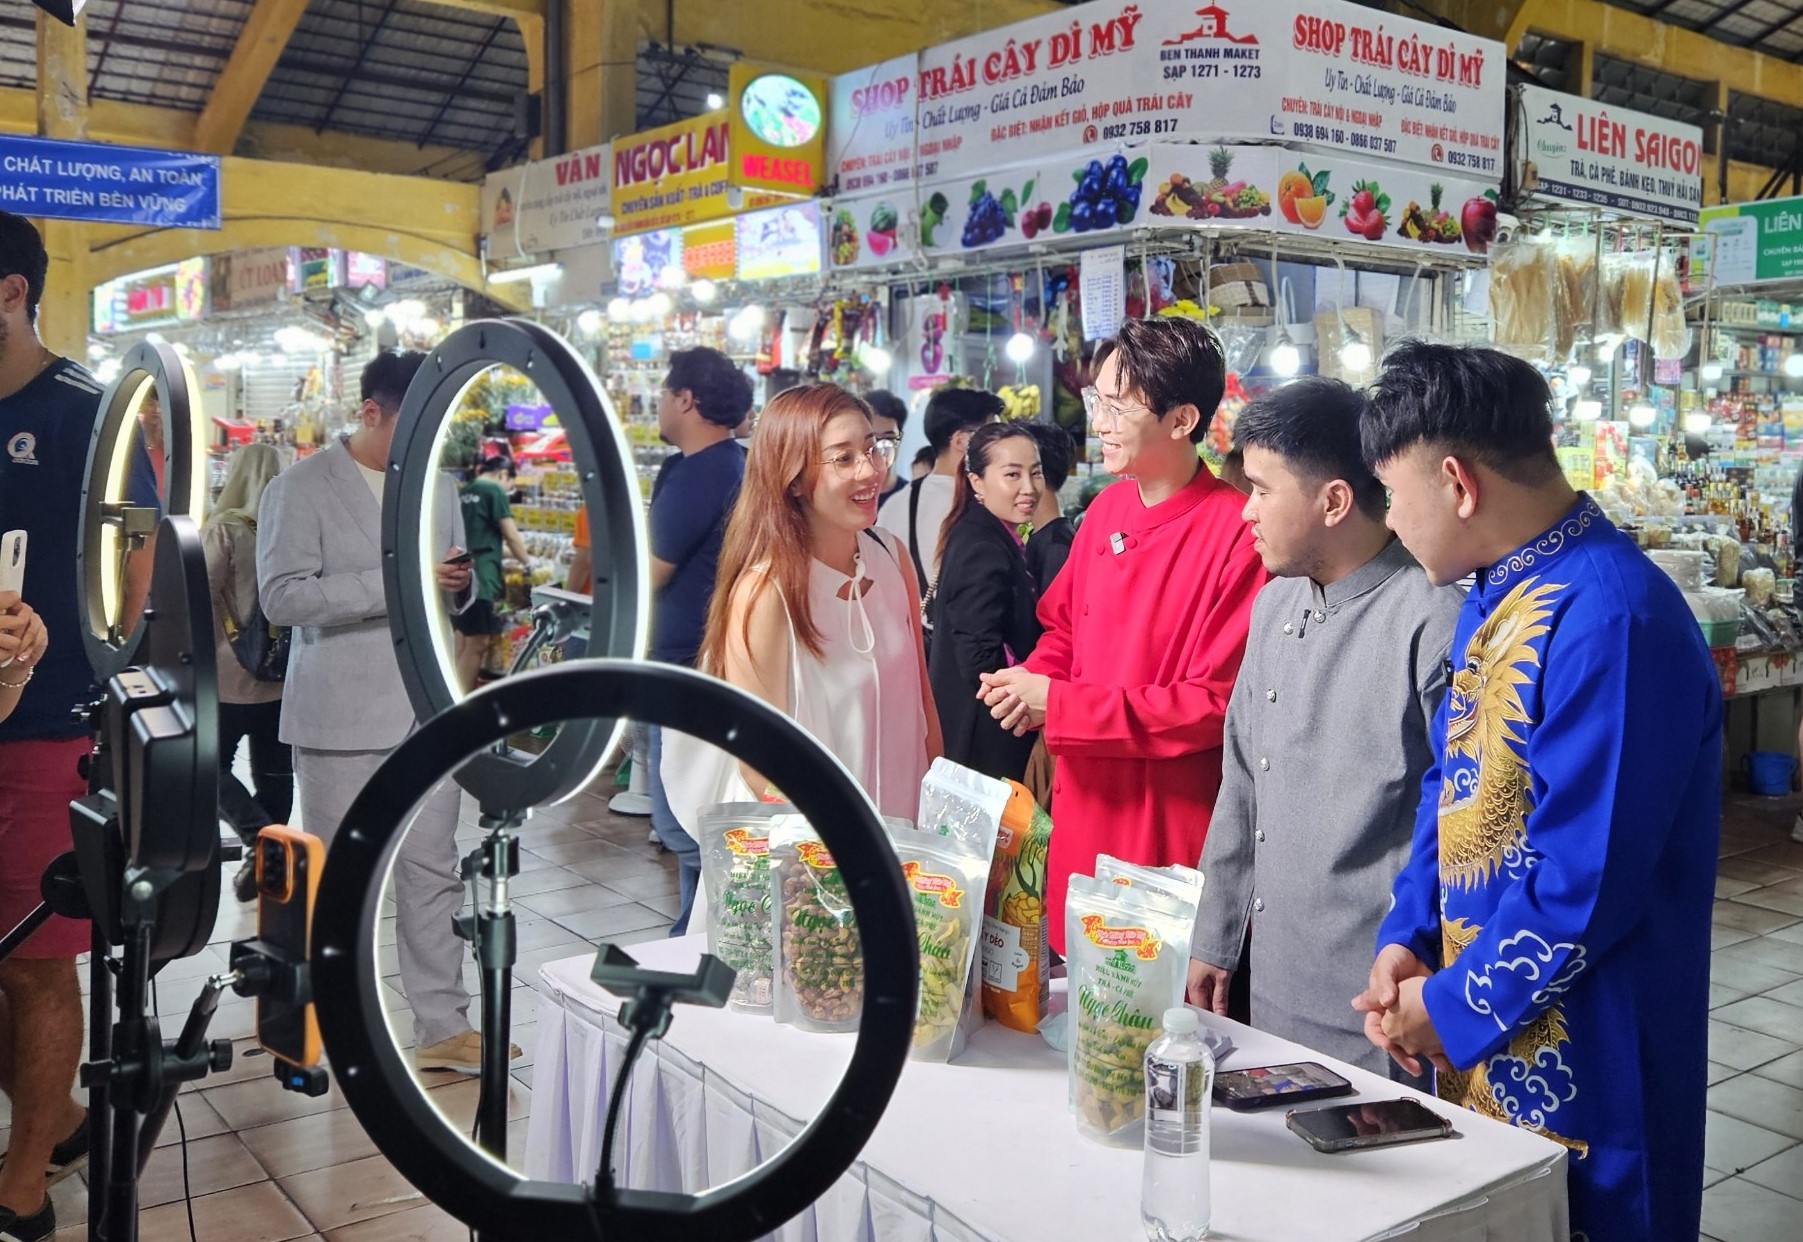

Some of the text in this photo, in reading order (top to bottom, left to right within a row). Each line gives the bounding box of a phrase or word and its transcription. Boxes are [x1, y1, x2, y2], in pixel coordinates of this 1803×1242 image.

[851, 77, 909, 116] SHOP
[918, 54, 976, 102] TRÁI
[983, 39, 1042, 84] CÂY
[1048, 20, 1085, 69] DÌ
[1088, 4, 1142, 59] MỸ
[1184, 48, 1220, 60] THANH
[1223, 48, 1260, 60] MAKET
[1294, 13, 1485, 88] SHOP TRÁI CÂY DÌ MỸ
[1163, 65, 1187, 82] SẠP
[1190, 65, 1219, 78] 1271
[1232, 65, 1261, 79] 1273
[991, 92, 1010, 114] Giá
[1061, 74, 1085, 97] Bảo
[1136, 94, 1163, 112] TRÁI
[1167, 92, 1193, 109] CÂY
[1103, 119, 1178, 140] 0932 758 817
[1294, 122, 1314, 139] 0938
[1315, 126, 1329, 140] 694
[1331, 129, 1344, 144] 160
[1351, 132, 1368, 148] 0866
[1370, 136, 1382, 151] 037
[1384, 139, 1397, 153] 507
[1577, 111, 1626, 159] LIÊN
[555, 151, 600, 187] VÂN
[615, 134, 683, 188] NGỌC
[741, 153, 815, 187] WEASEL
[1448, 150, 1495, 171] 0932 758 817
[129, 167, 153, 183] AN
[157, 168, 203, 185] TOÀN
[1620, 168, 1640, 190] BÁNH
[0, 183, 38, 201] HÁT
[139, 193, 187, 213] VỮNG
[1764, 211, 1802, 234] LIÊN
[1109, 999, 1154, 1030] Châu
